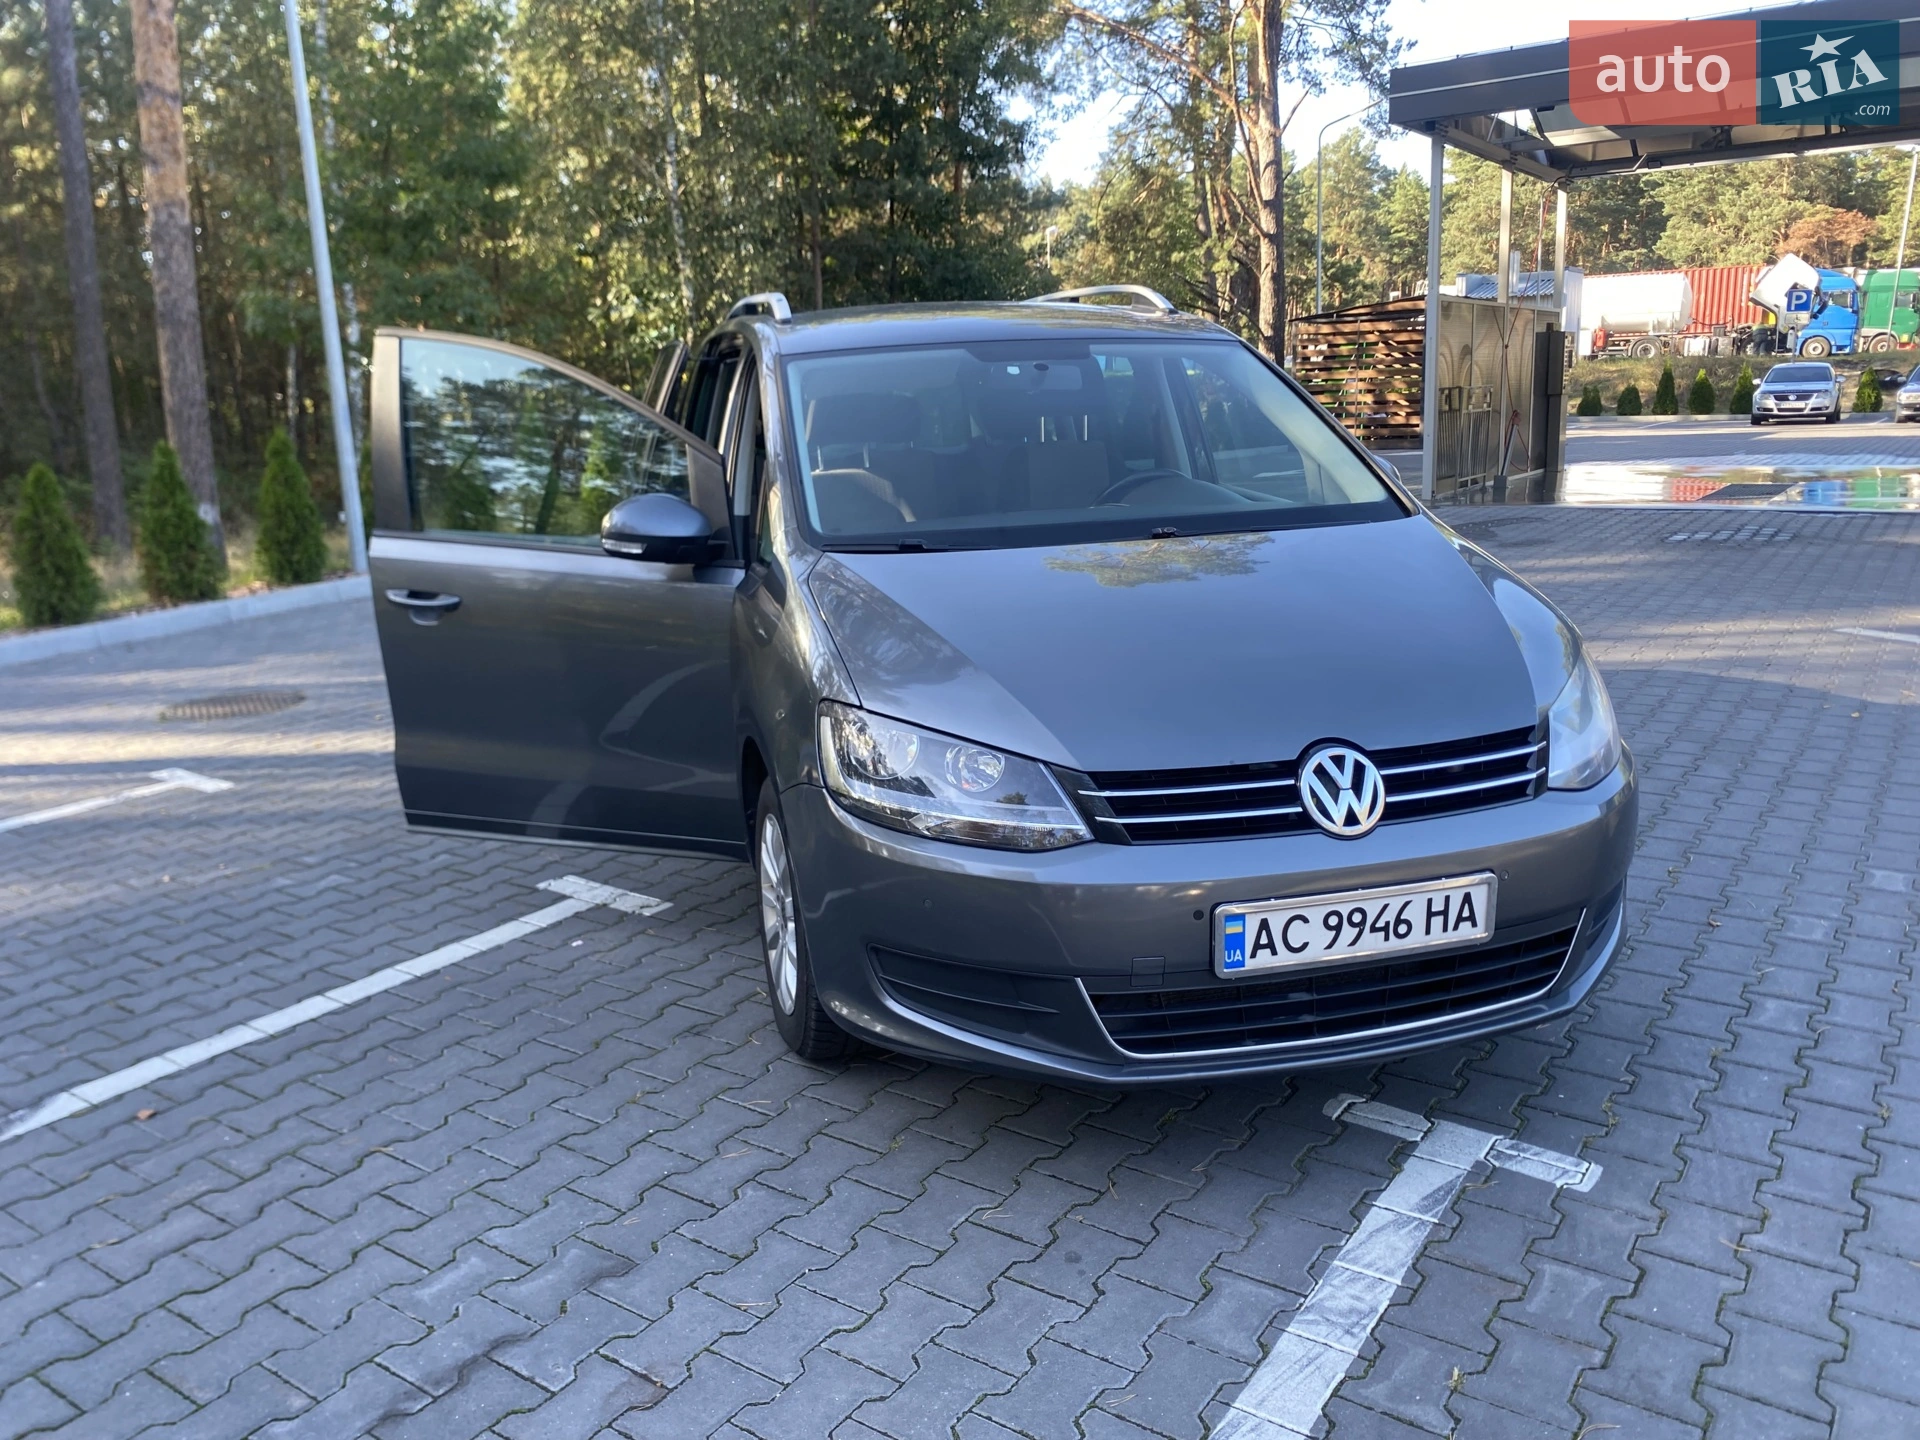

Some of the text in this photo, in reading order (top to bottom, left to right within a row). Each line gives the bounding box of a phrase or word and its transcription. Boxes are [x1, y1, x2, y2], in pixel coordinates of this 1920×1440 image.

[1790, 291, 1808, 311] P
[1249, 891, 1478, 959] AC 9946 HA
[1224, 948, 1243, 963] UA
